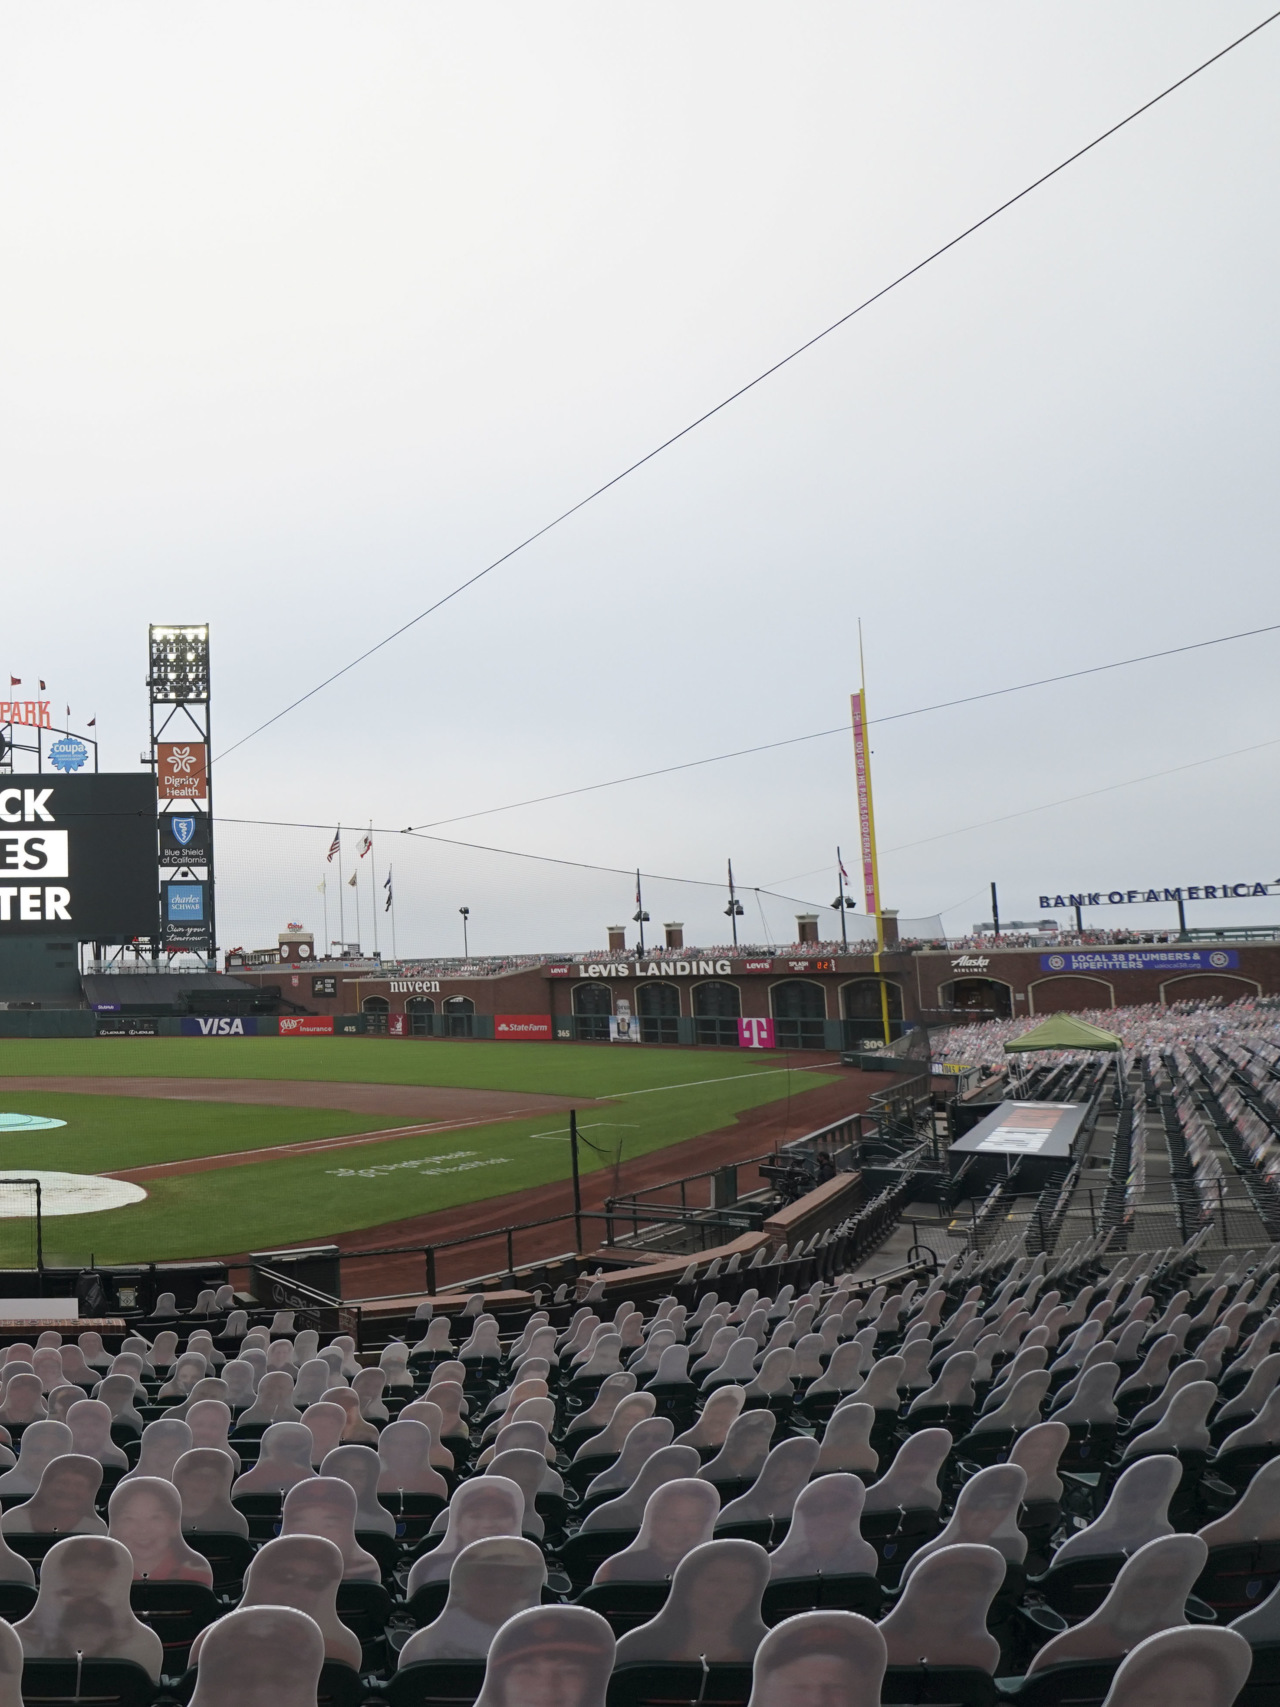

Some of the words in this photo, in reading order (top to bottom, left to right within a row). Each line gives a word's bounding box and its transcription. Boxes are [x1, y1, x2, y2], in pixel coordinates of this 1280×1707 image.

[0, 701, 52, 730] PARK
[54, 744, 84, 755] coupa
[164, 776, 199, 787] Dignity
[859, 788, 868, 808] PARK
[171, 894, 199, 903] charles
[1039, 893, 1100, 909] BANK
[1108, 890, 1138, 904] OF
[1144, 882, 1268, 902] AMERICA
[186, 927, 206, 936] your
[951, 955, 990, 967] Alaska
[1072, 954, 1108, 962] LOCAL
[1111, 954, 1126, 962] 38
[1128, 953, 1190, 961] PLUMBERS
[635, 960, 732, 976] LANDING
[1072, 961, 1143, 969] PIPEFITTERS
[390, 981, 440, 993] nuveen
[195, 1018, 244, 1035] VISA
[280, 1019, 297, 1029] AAA
[557, 1030, 570, 1038] 365
[863, 1040, 884, 1049] 309
